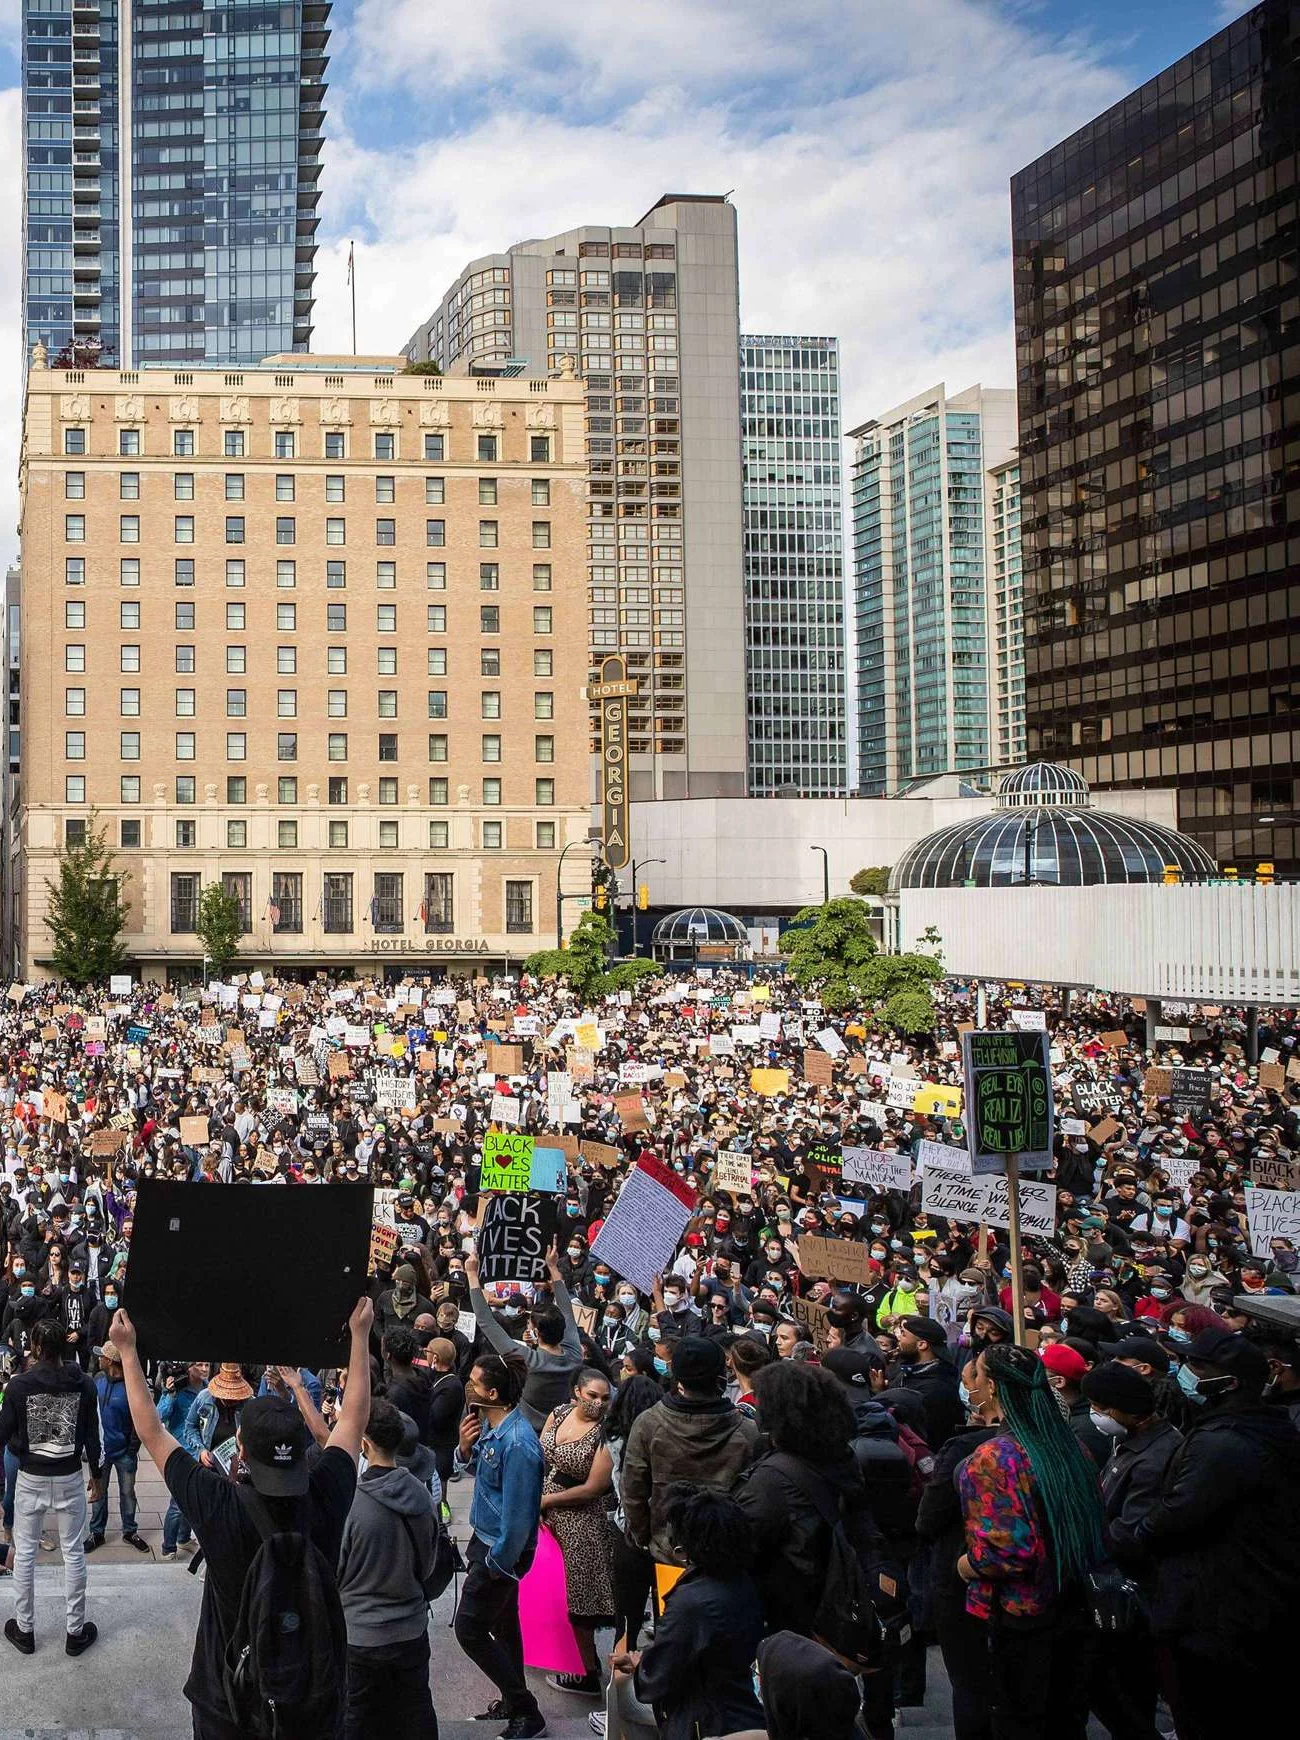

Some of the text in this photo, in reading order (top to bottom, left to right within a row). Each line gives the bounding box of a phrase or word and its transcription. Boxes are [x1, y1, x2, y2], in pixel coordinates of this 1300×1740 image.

[592, 683, 632, 697] HOTEL
[605, 703, 624, 848] GEORGIA
[372, 939, 489, 951] HOTEL GEORGIA
[363, 1069, 396, 1079] BLACK
[381, 1080, 410, 1089] HISTORY
[891, 1082, 902, 1090] NO
[980, 1077, 1003, 1097] REAL
[1076, 1081, 1116, 1095] BLACK
[890, 1093, 902, 1102] NO
[1081, 1095, 1124, 1109] MATTER
[111, 1112, 133, 1128] BLM
[485, 1135, 533, 1154] BLACK
[984, 1125, 1006, 1149] REAL
[807, 1151, 844, 1165] POLICE
[858, 1150, 894, 1163] STOP
[1162, 1160, 1198, 1169] SILENCE
[844, 1157, 908, 1177] KILLING THE
[925, 1166, 972, 1185] THERE
[1252, 1159, 1295, 1179] BLACK
[481, 1173, 530, 1190] MATTER
[719, 1172, 750, 1184] BETRAYAL
[933, 1183, 1029, 1209] A TIME WHN
[485, 1196, 541, 1225] LACK
[925, 1194, 979, 1214] SILENCE
[981, 1206, 998, 1218] IS
[1253, 1214, 1300, 1234] LIVES
[481, 1225, 542, 1256] IVES
[479, 1254, 547, 1280] ATTER
